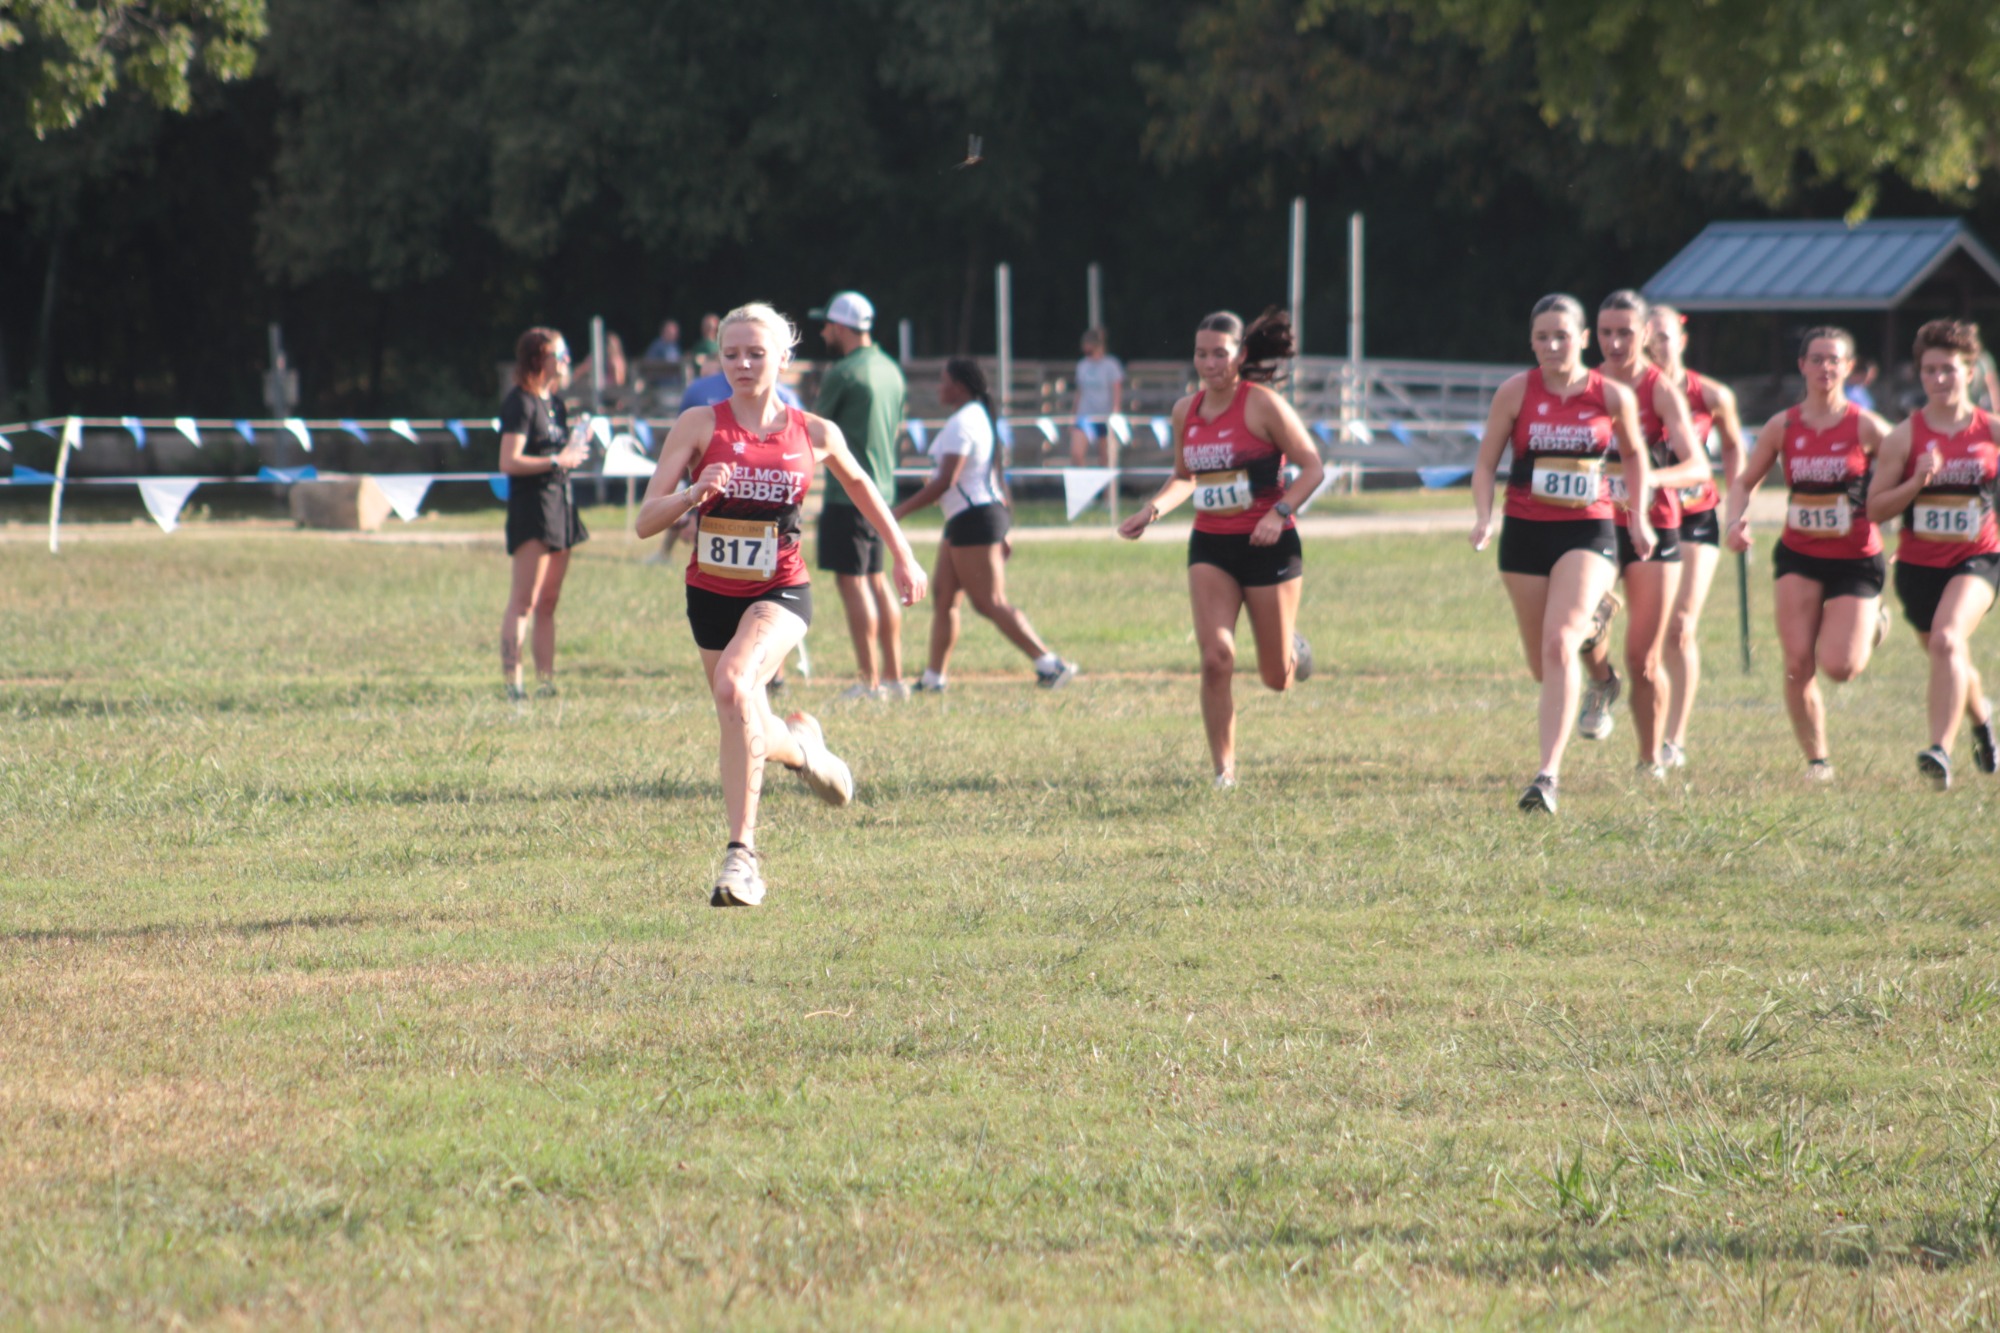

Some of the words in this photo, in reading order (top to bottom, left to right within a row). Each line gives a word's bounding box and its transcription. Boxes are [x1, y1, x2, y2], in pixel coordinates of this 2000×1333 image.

[1529, 423, 1598, 438] BELMONT
[1528, 435, 1599, 452] ABBEY
[730, 466, 804, 486] ELMONT
[1544, 472, 1588, 497] 810
[724, 480, 802, 504] ABBEY
[1204, 486, 1237, 507] 811
[1799, 509, 1838, 527] 815
[1925, 510, 1968, 530] 816
[710, 536, 762, 566] 817
